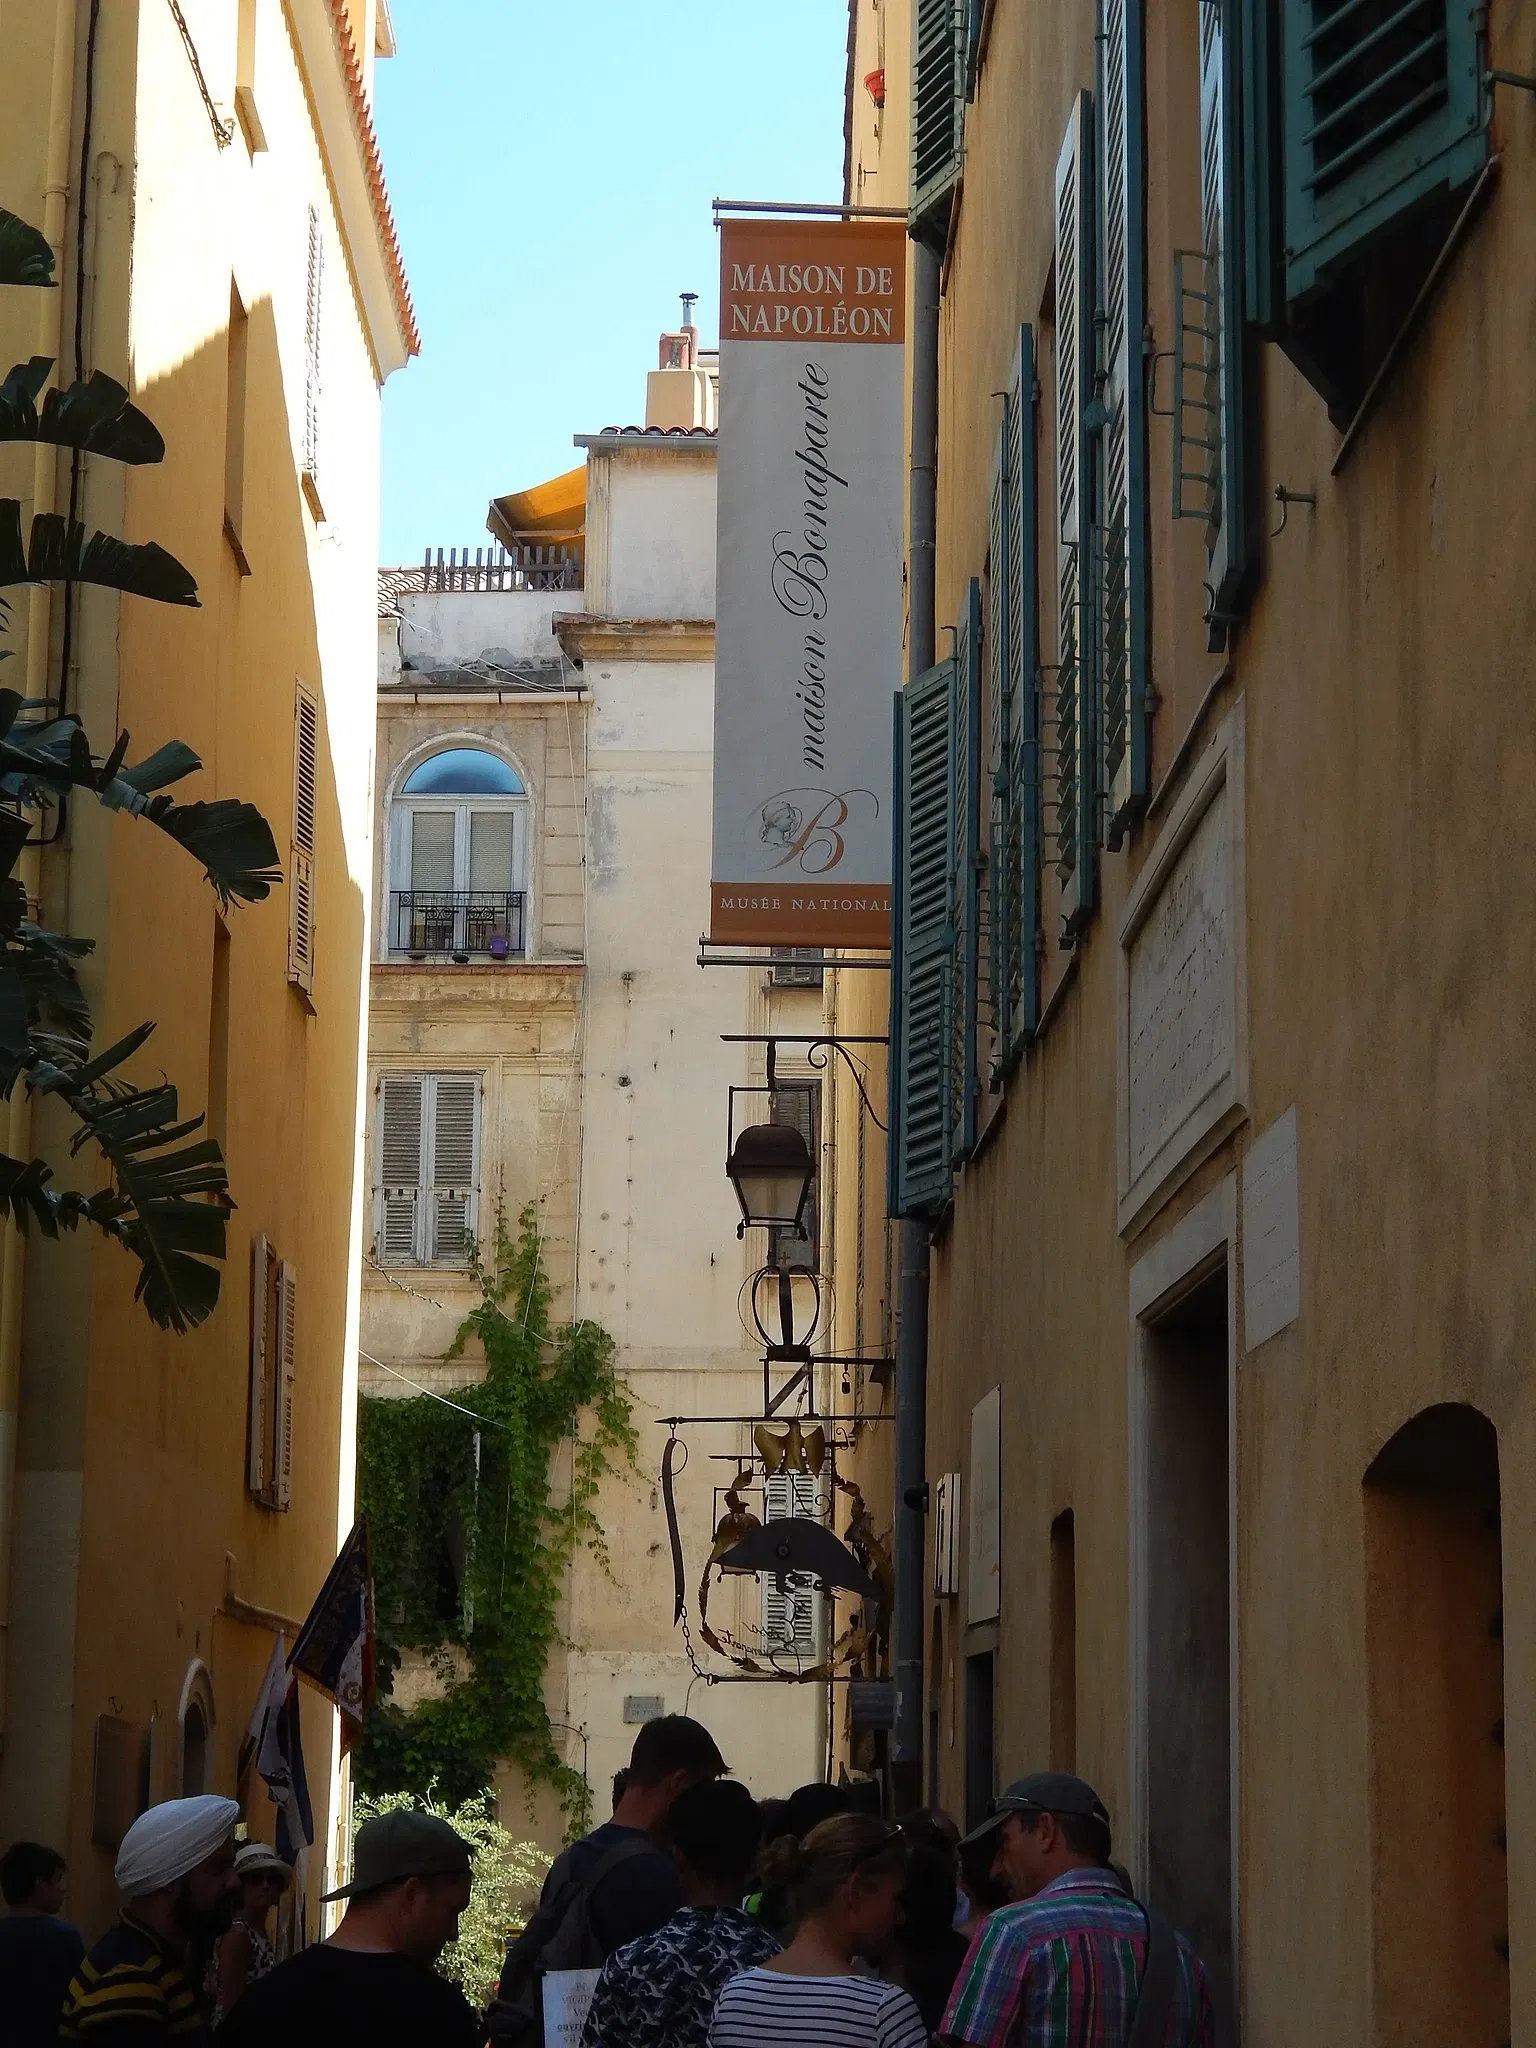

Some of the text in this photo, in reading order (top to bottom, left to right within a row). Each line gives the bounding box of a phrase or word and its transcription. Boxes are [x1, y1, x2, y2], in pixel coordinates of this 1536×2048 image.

[730, 263, 894, 296] MAISON DE
[730, 300, 893, 337] NAPOLÉON
[772, 362, 849, 771] maison Bonaparte
[720, 896, 892, 912] MUSÉE NATIONAL
